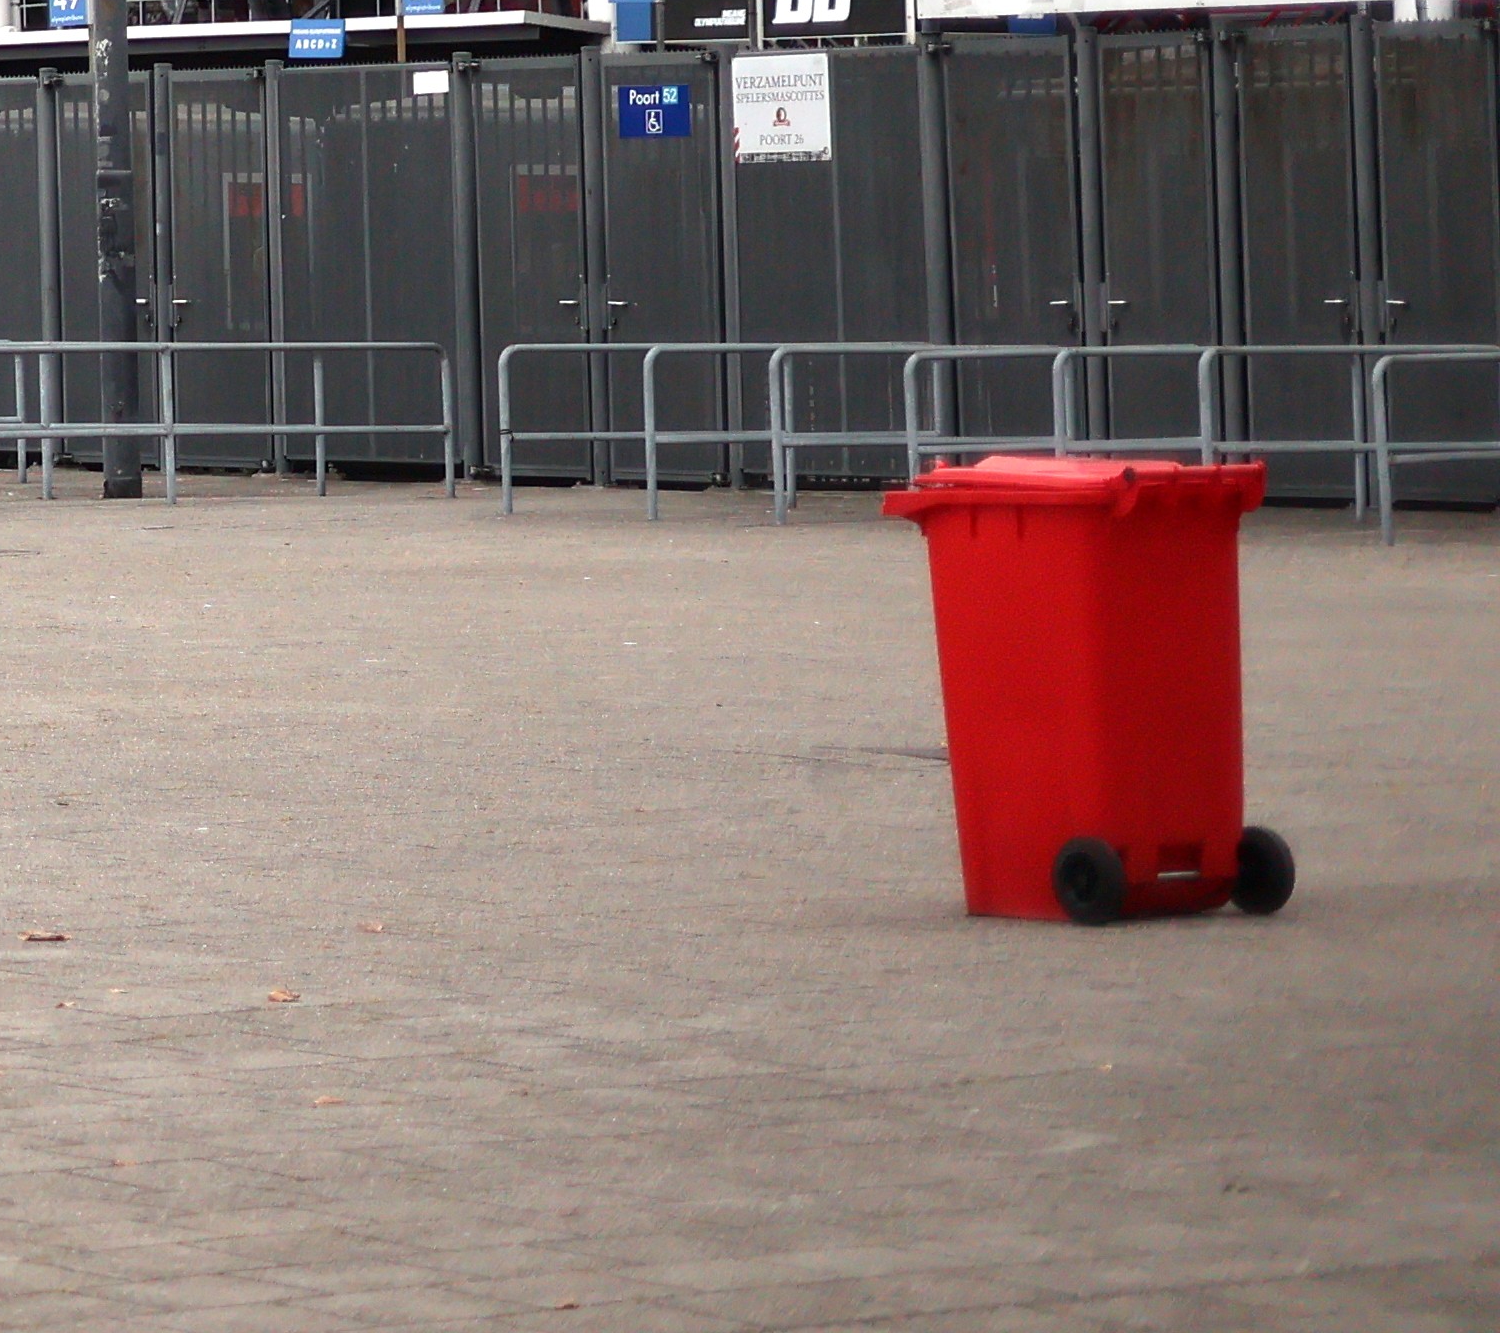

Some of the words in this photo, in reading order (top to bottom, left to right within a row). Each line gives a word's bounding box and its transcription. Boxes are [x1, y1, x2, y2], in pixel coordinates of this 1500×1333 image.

[736, 74, 824, 89] VERZAMELPUNT
[629, 90, 659, 105] Poort
[663, 87, 678, 103] 52
[736, 89, 824, 103] SPELERSMASCOTTES
[759, 135, 792, 146] POORT
